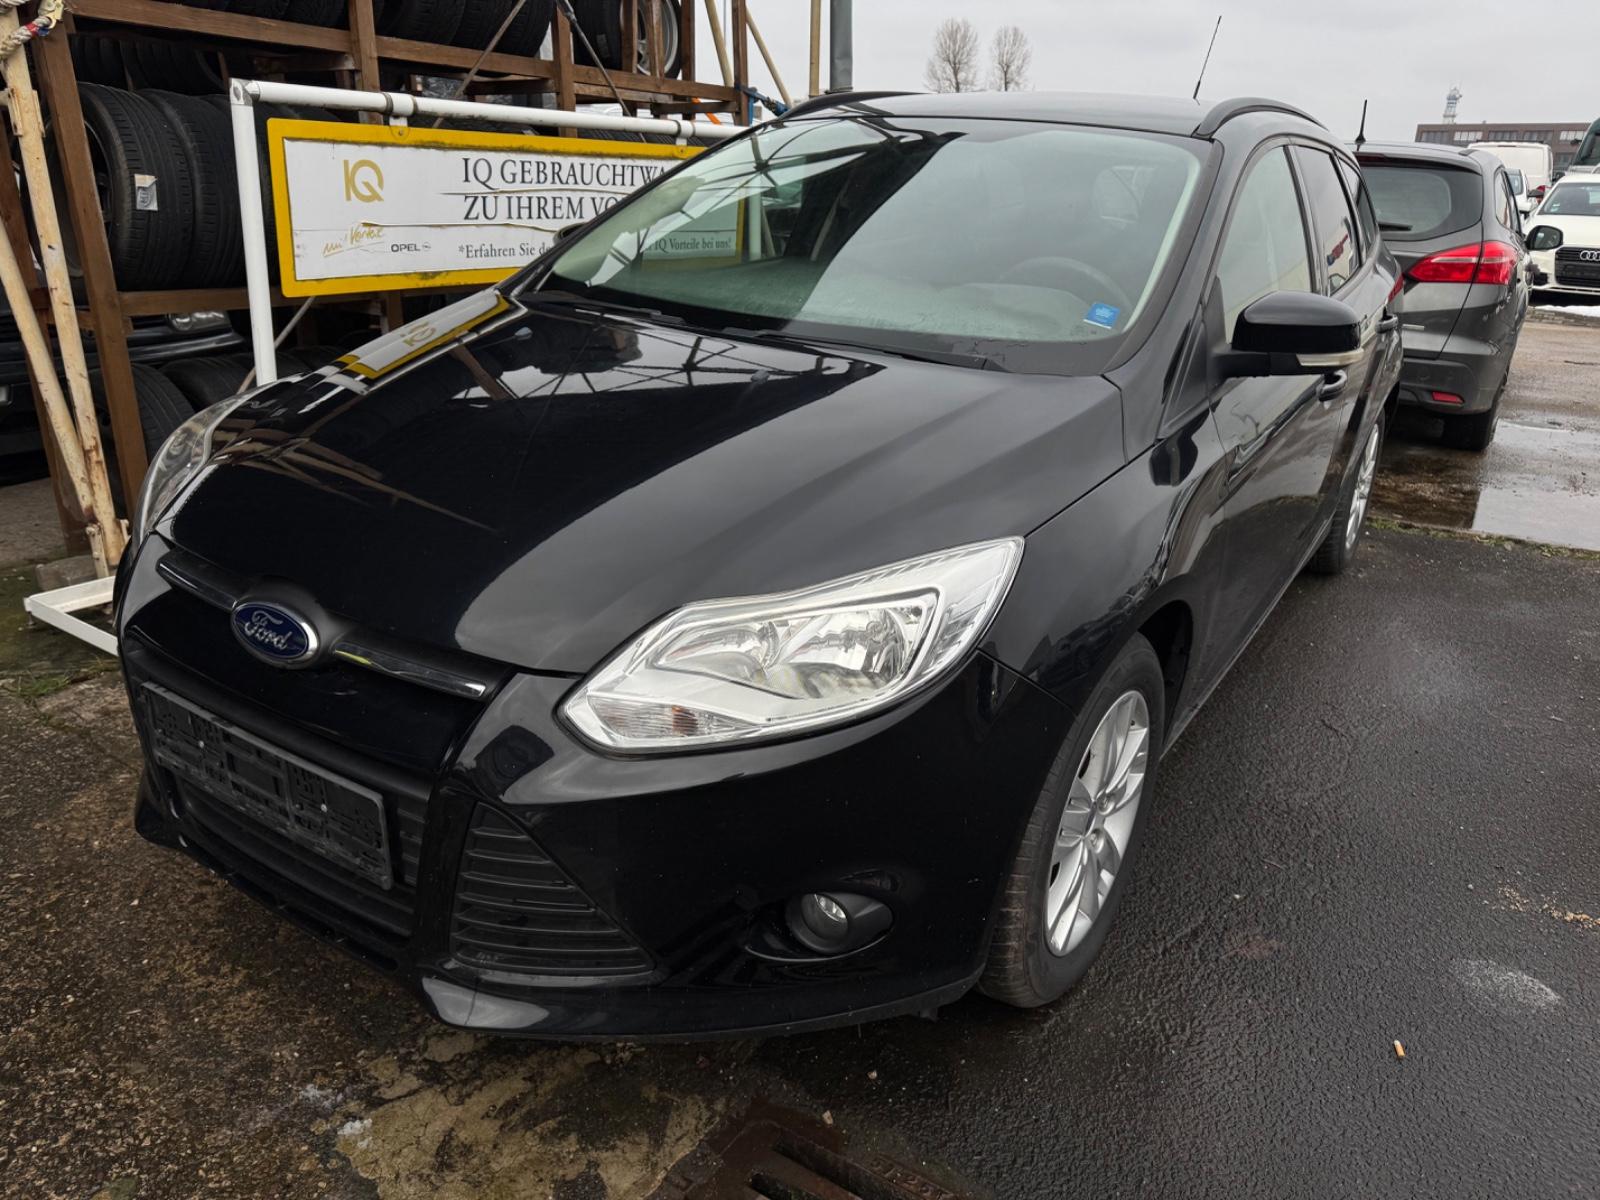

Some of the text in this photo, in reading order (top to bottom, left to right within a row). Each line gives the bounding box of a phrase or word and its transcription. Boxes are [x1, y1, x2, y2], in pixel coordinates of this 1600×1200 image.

[343, 159, 384, 203] IQ
[462, 157, 499, 190] IQ
[464, 195, 499, 220] ZU
[506, 195, 585, 220] IHREM
[391, 243, 420, 253] OPEL
[519, 242, 535, 256] Sie
[702, 237, 714, 249] bei
[245, 610, 293, 650] Ford
